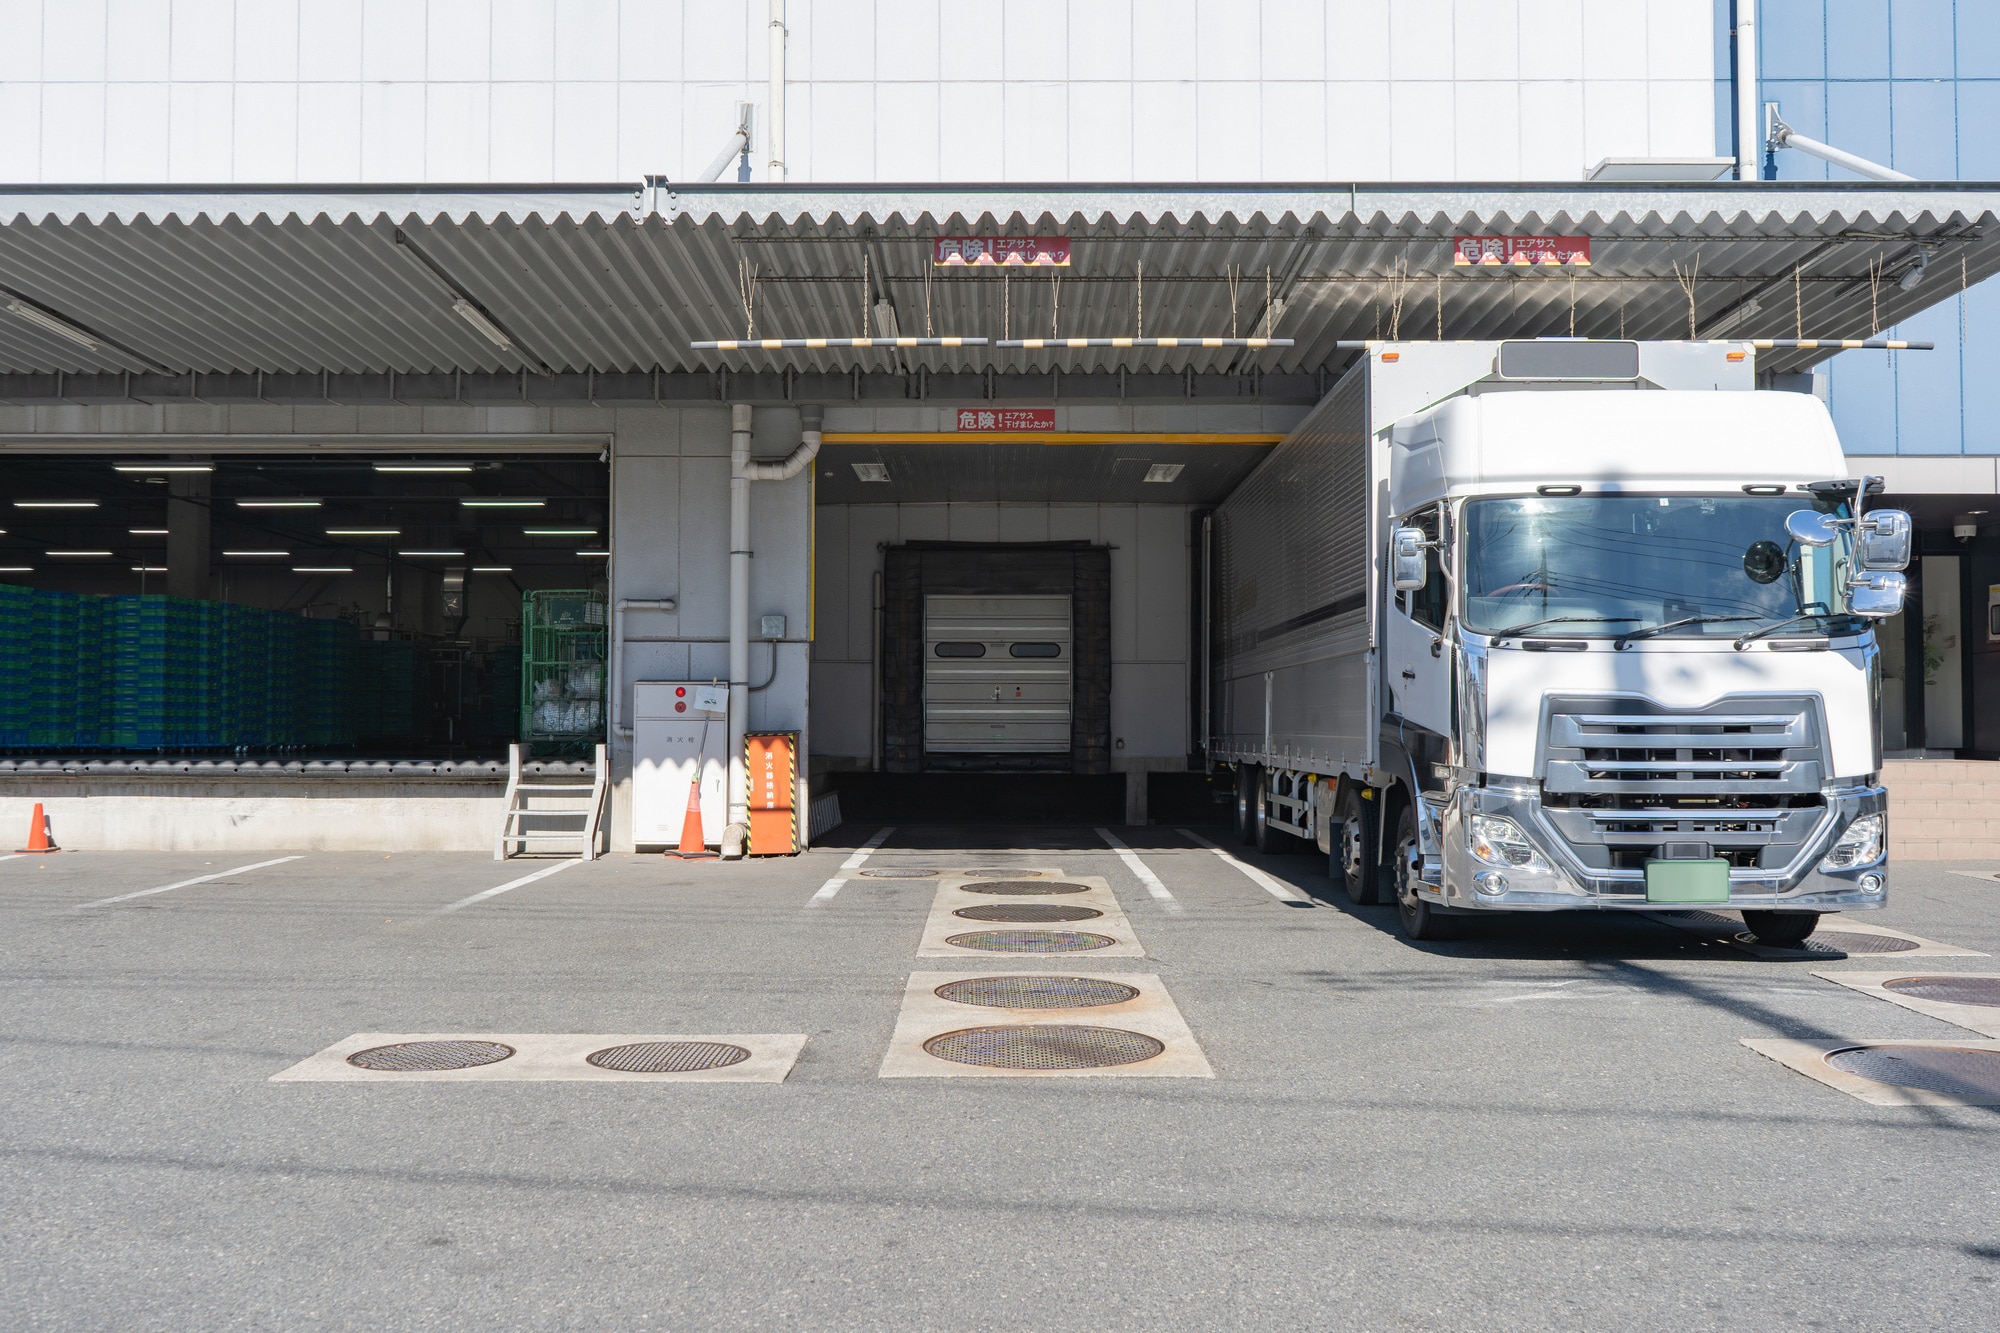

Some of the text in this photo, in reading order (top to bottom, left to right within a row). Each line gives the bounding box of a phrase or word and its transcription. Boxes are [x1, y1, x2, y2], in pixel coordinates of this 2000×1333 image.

[997, 239, 1036, 248] エアサス
[1516, 238, 1556, 248] エアサス
[939, 239, 993, 260] 危険!
[1458, 238, 1513, 260] 危険!
[997, 250, 1065, 260] 下げましたか?
[1518, 250, 1585, 260] 下げましたか?
[959, 411, 1003, 429] 危険!
[1004, 412, 1034, 420] エアサス
[1004, 420, 1054, 429] 下げましたか?
